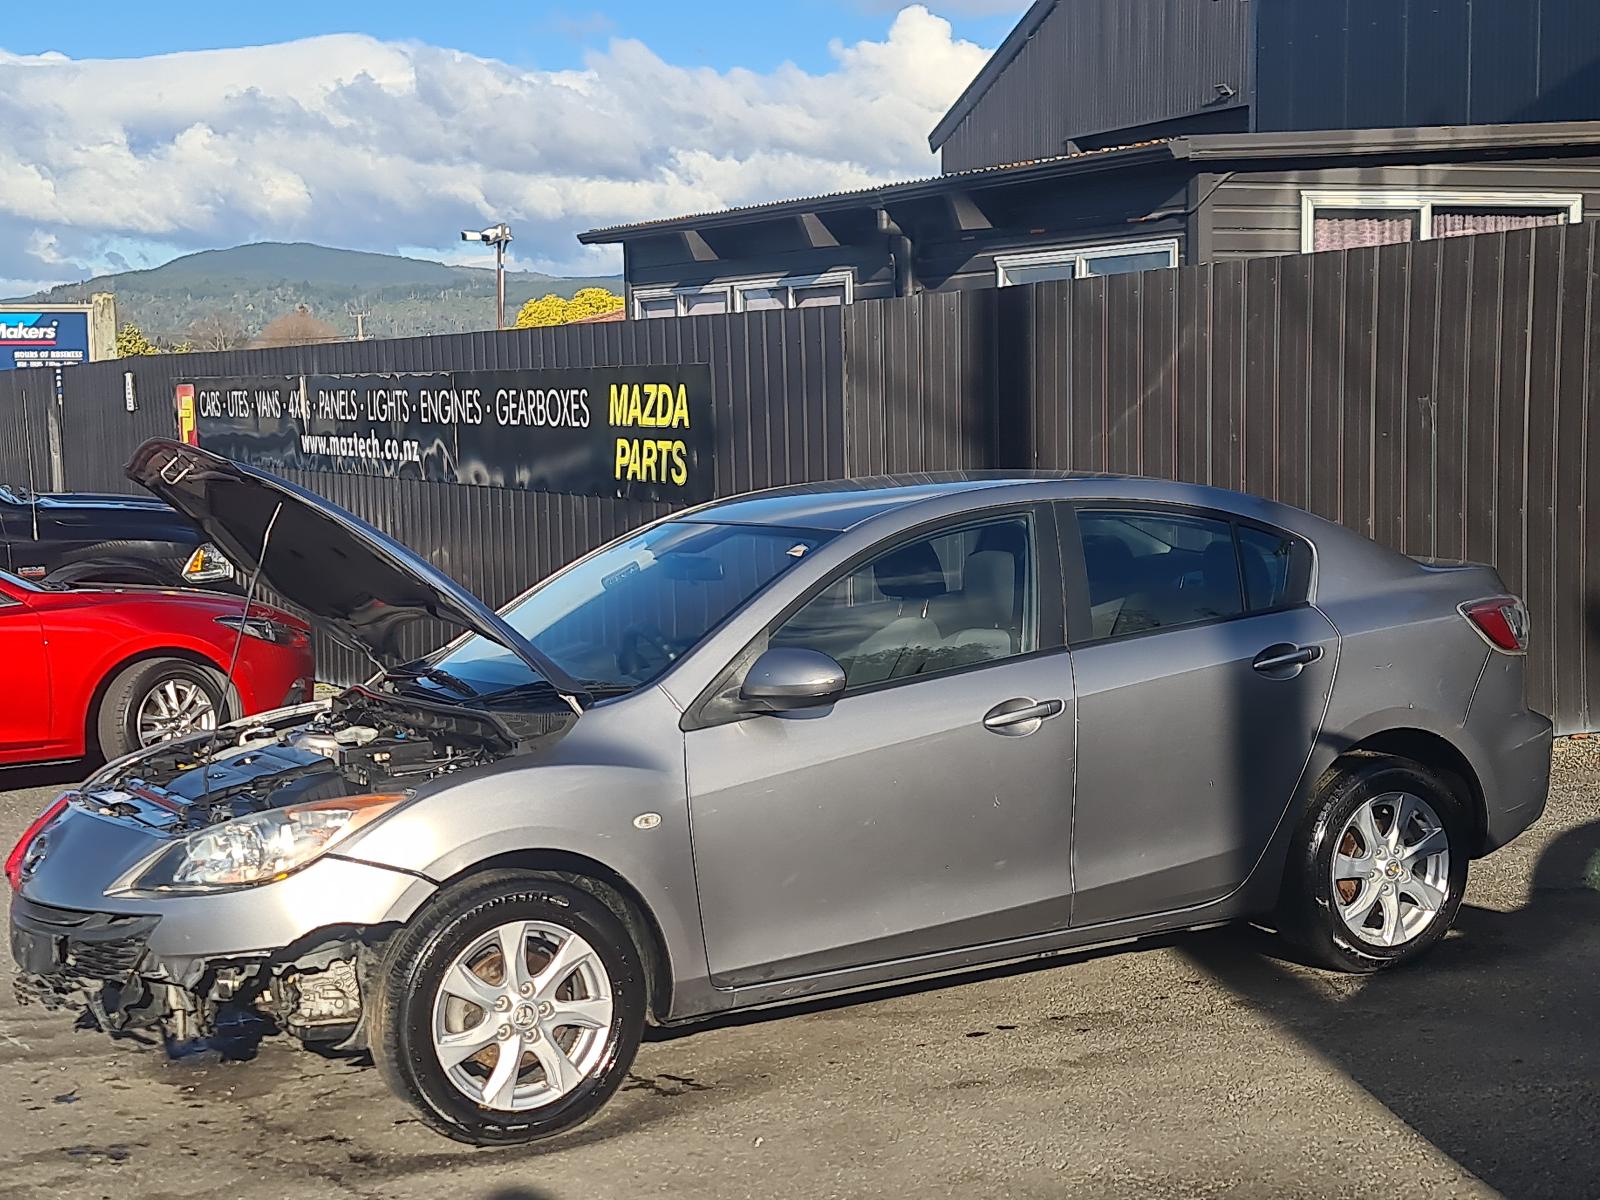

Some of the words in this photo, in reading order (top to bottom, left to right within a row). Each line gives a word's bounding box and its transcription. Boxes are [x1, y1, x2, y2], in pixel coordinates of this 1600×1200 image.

[200, 390, 221, 417] CARS
[227, 390, 249, 418] UTES
[255, 390, 281, 418] VANS
[288, 389, 311, 420] 4Xs
[319, 389, 358, 421] PANELS
[367, 388, 410, 422] LIGHTS
[420, 389, 482, 424] ENGINES
[495, 389, 590, 428] GEARBOXES
[608, 383, 690, 428] MAZDA
[301, 429, 420, 462] www.maztech.co.nz
[615, 438, 688, 486] PARTS
